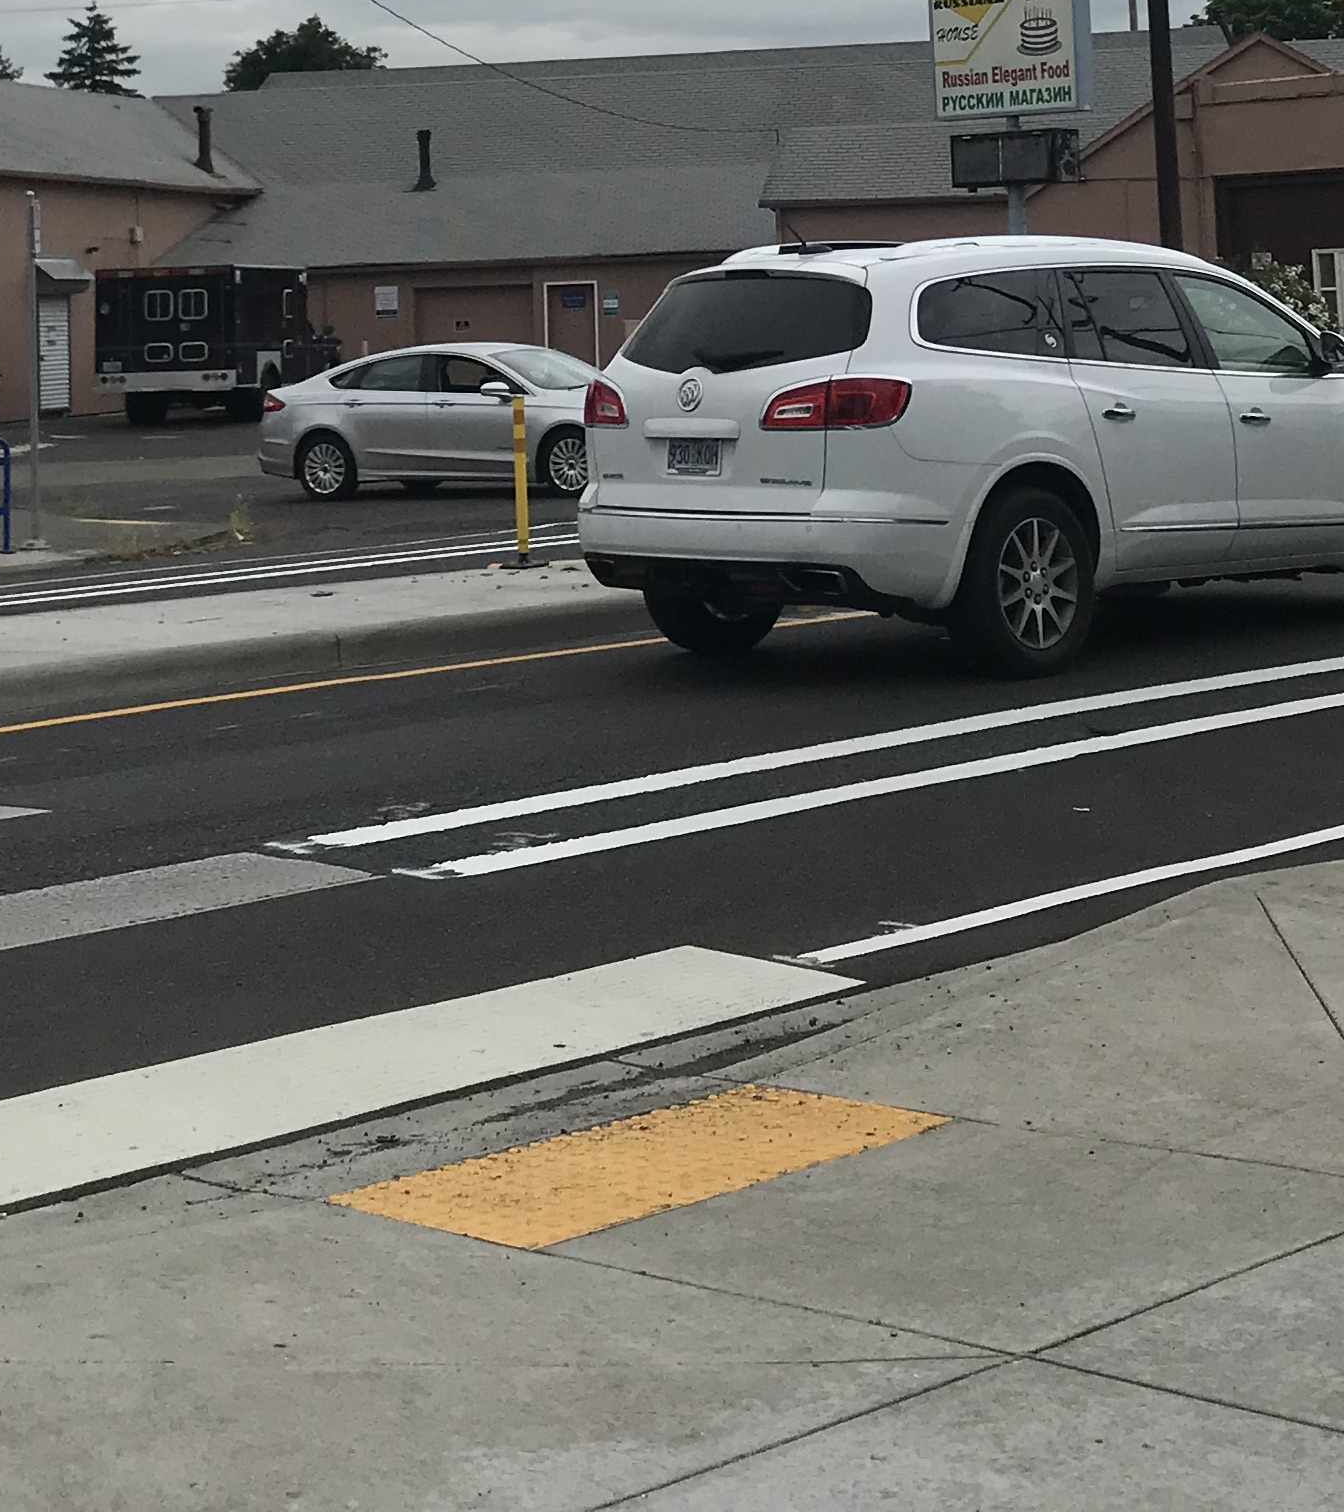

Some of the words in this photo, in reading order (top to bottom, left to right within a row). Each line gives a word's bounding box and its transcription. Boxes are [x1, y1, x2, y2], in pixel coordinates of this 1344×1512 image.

[936, 24, 979, 43] HOUSE
[942, 68, 989, 89] Russian
[991, 63, 1038, 87] Elegant
[1040, 60, 1070, 80] Food
[1009, 85, 1072, 107] МАГАЗИН
[669, 444, 691, 465] 930
